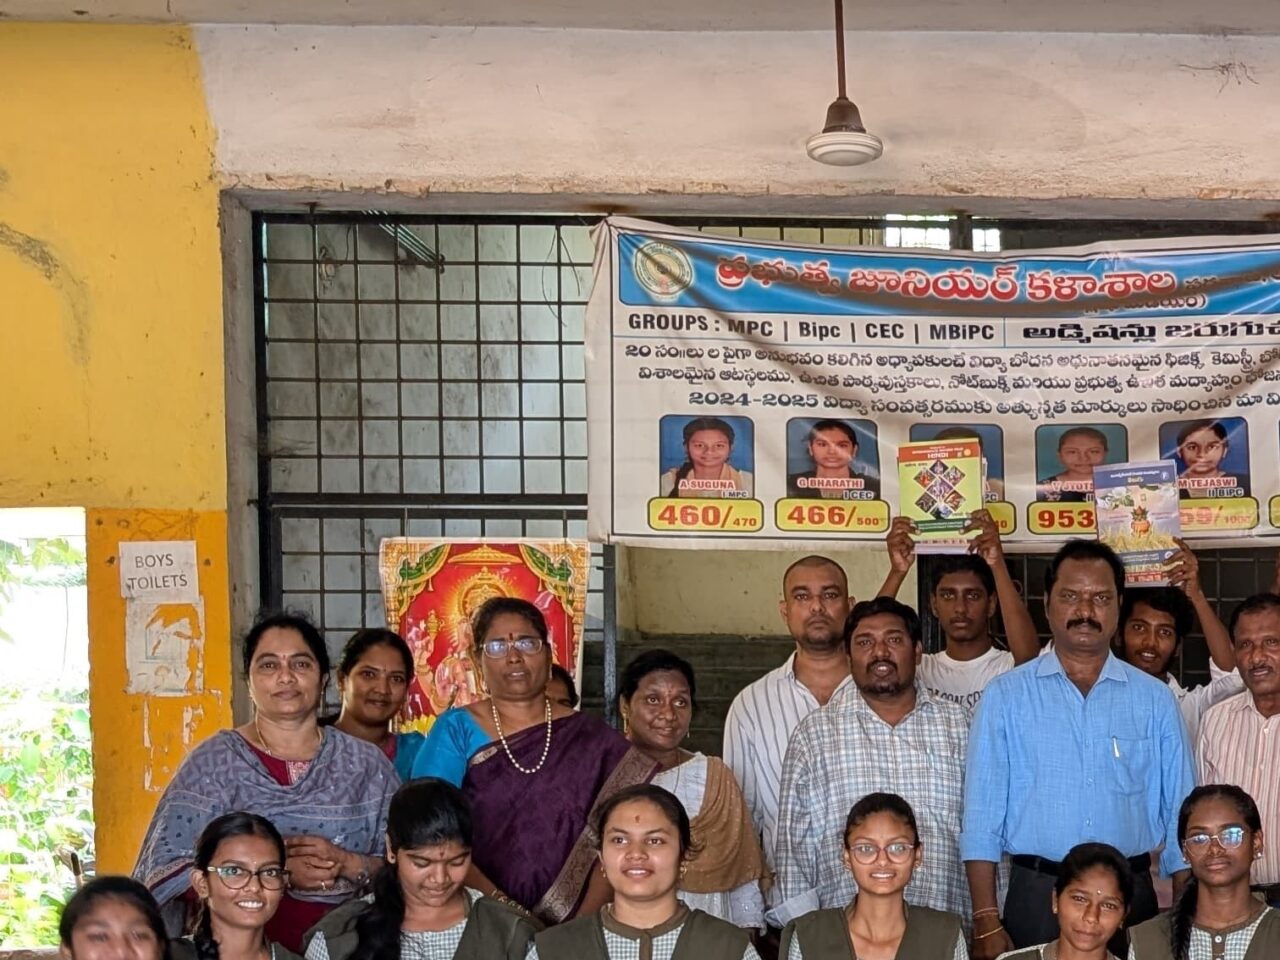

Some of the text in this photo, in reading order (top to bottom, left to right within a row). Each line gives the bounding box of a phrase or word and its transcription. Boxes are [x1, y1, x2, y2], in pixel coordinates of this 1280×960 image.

[850, 265, 1018, 300] జూనియర్
[1028, 271, 1176, 300] కళాశాల
[629, 313, 708, 331] GROUPS
[728, 319, 773, 336] MPC
[799, 321, 841, 341] Bipc
[866, 322, 904, 339] CEC
[930, 324, 995, 340] MBiPC
[625, 344, 650, 357] 20
[688, 391, 819, 408] 2024-2025
[679, 479, 735, 489] A SUGUNA
[808, 479, 864, 489] BHARATHI
[1190, 478, 1236, 488] TEJASWI
[850, 490, 874, 499] CEC
[135, 553, 174, 569] BOYS
[128, 574, 188, 590] TOILETS
